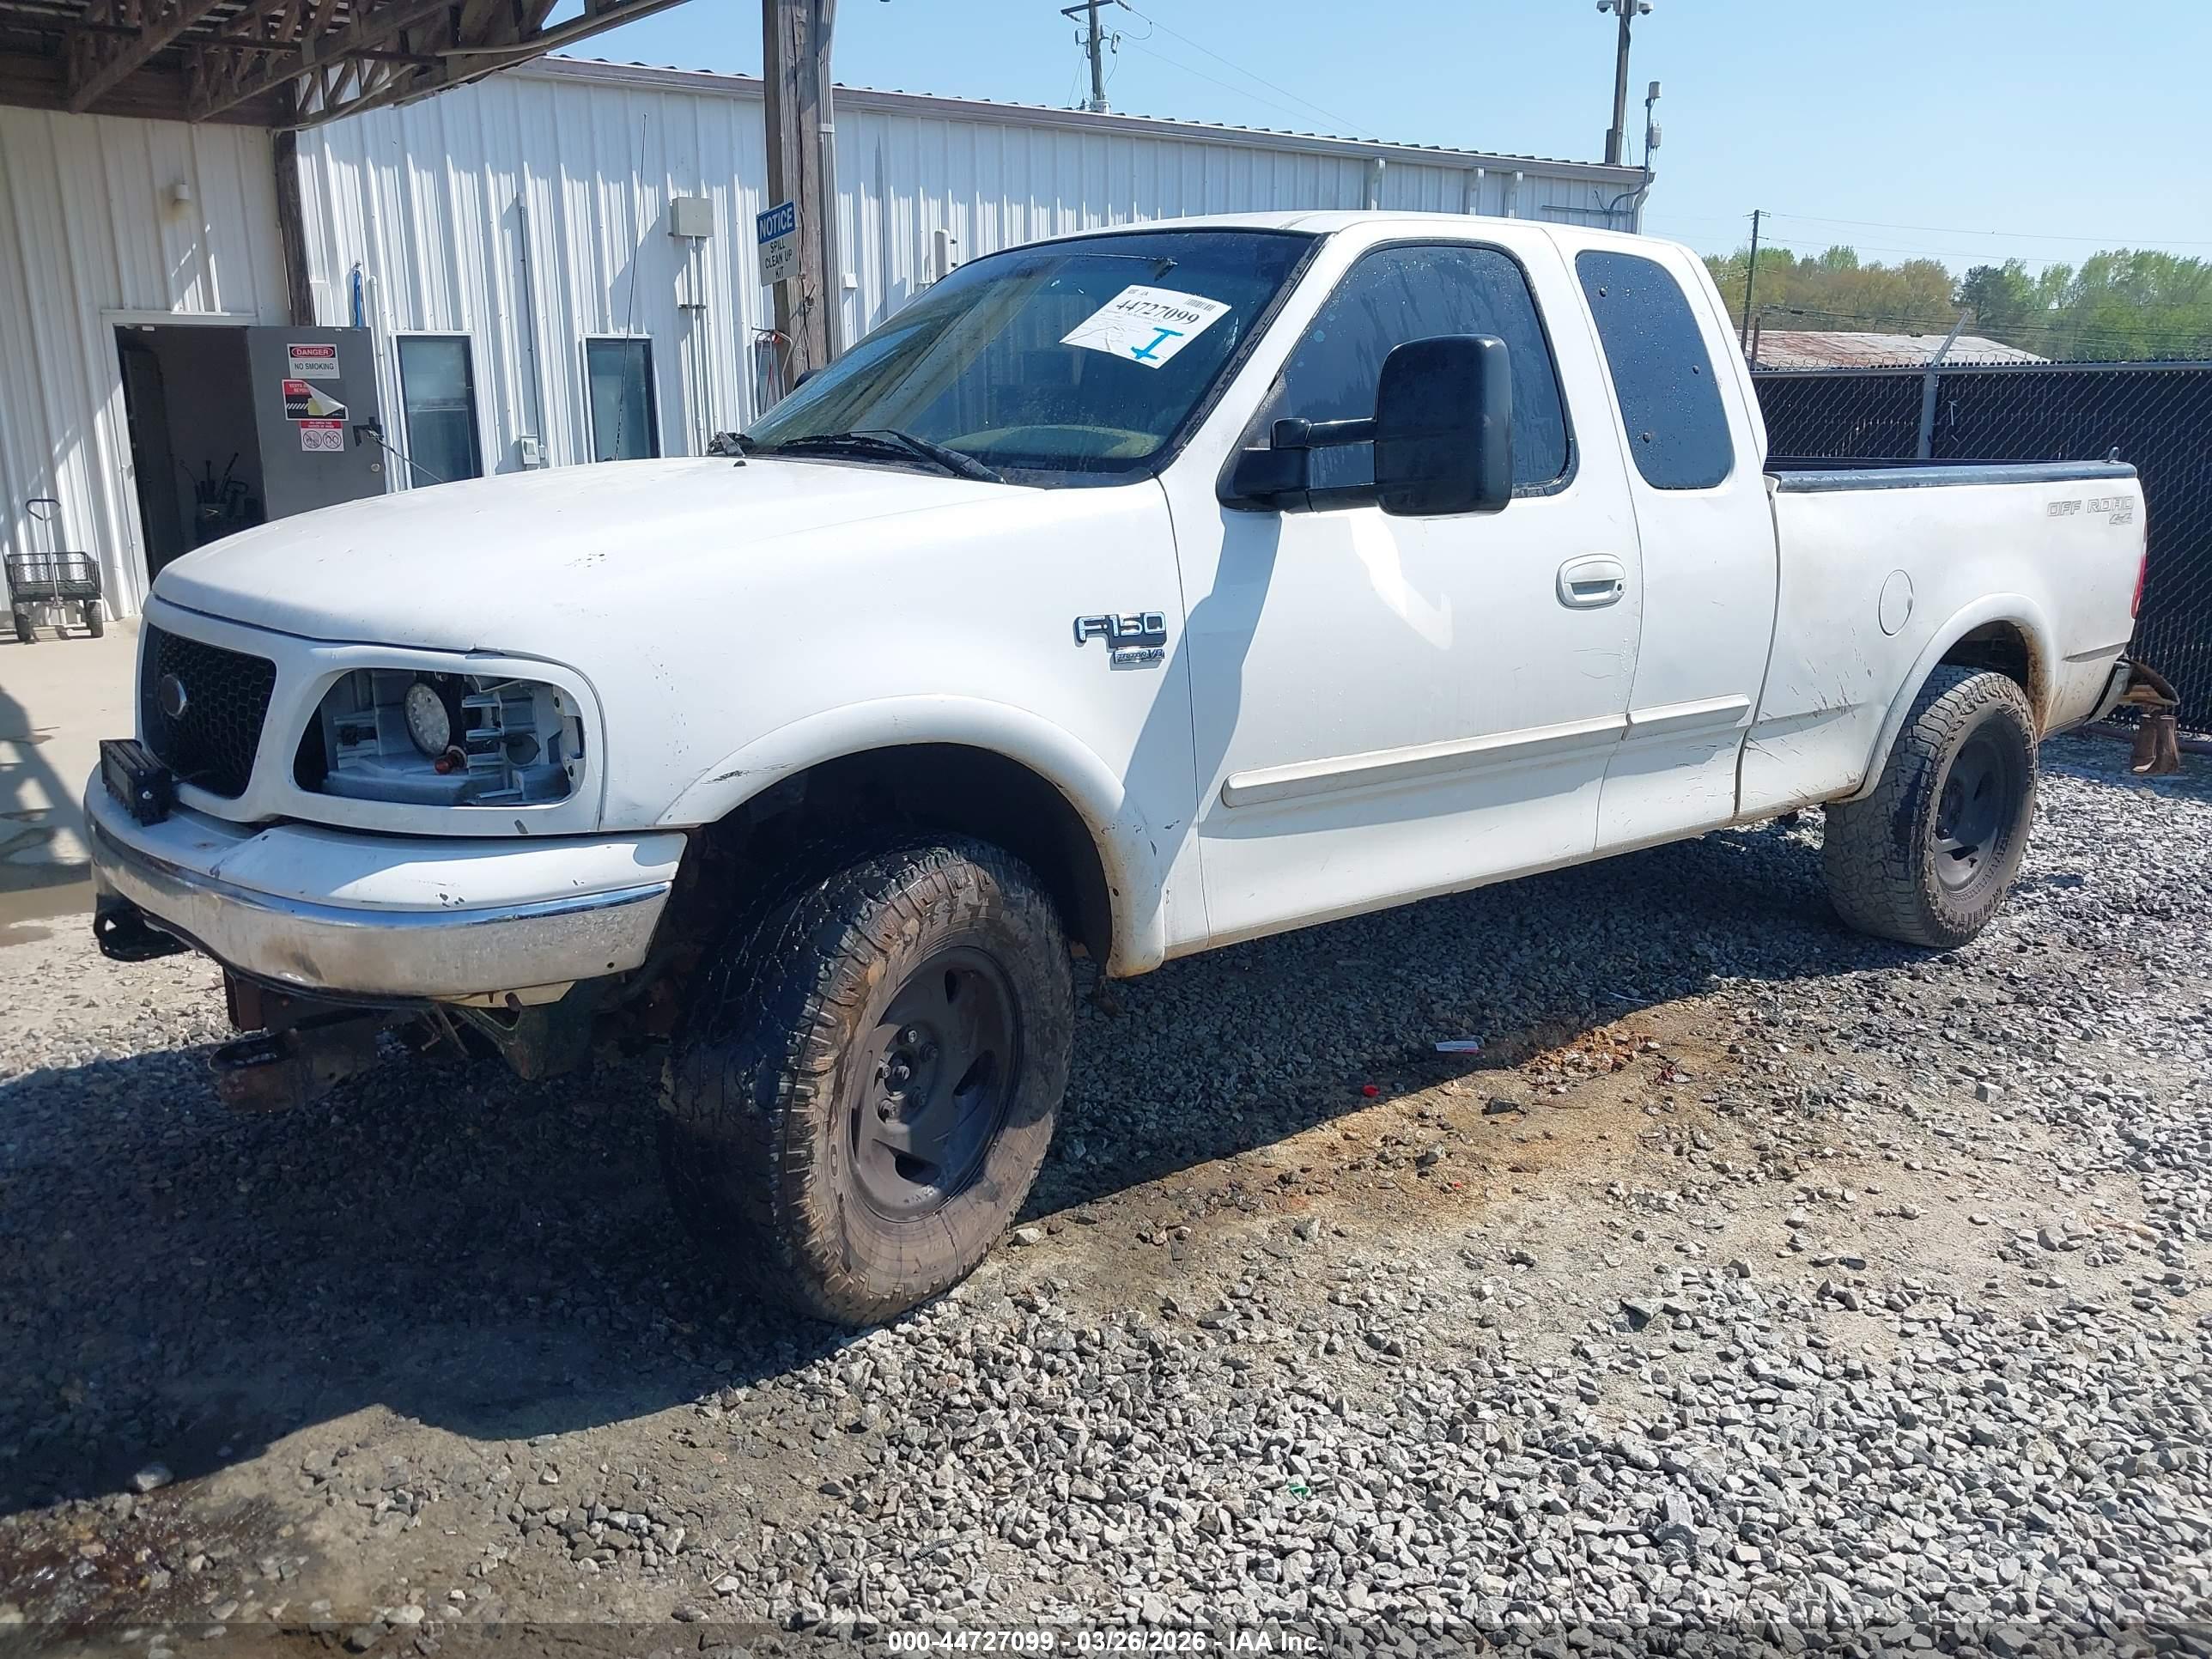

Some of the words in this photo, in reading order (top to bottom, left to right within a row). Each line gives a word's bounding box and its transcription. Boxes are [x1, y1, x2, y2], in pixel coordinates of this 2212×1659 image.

[760, 208, 793, 239] NOTICE
[769, 239, 785, 253] SPILL
[765, 254, 783, 269] CLEAN
[785, 249, 793, 262] UP
[775, 266, 784, 279] KIT
[1116, 299, 1200, 325] 44727099
[2047, 501, 2081, 517] OFF
[2087, 495, 2135, 514] ROAD
